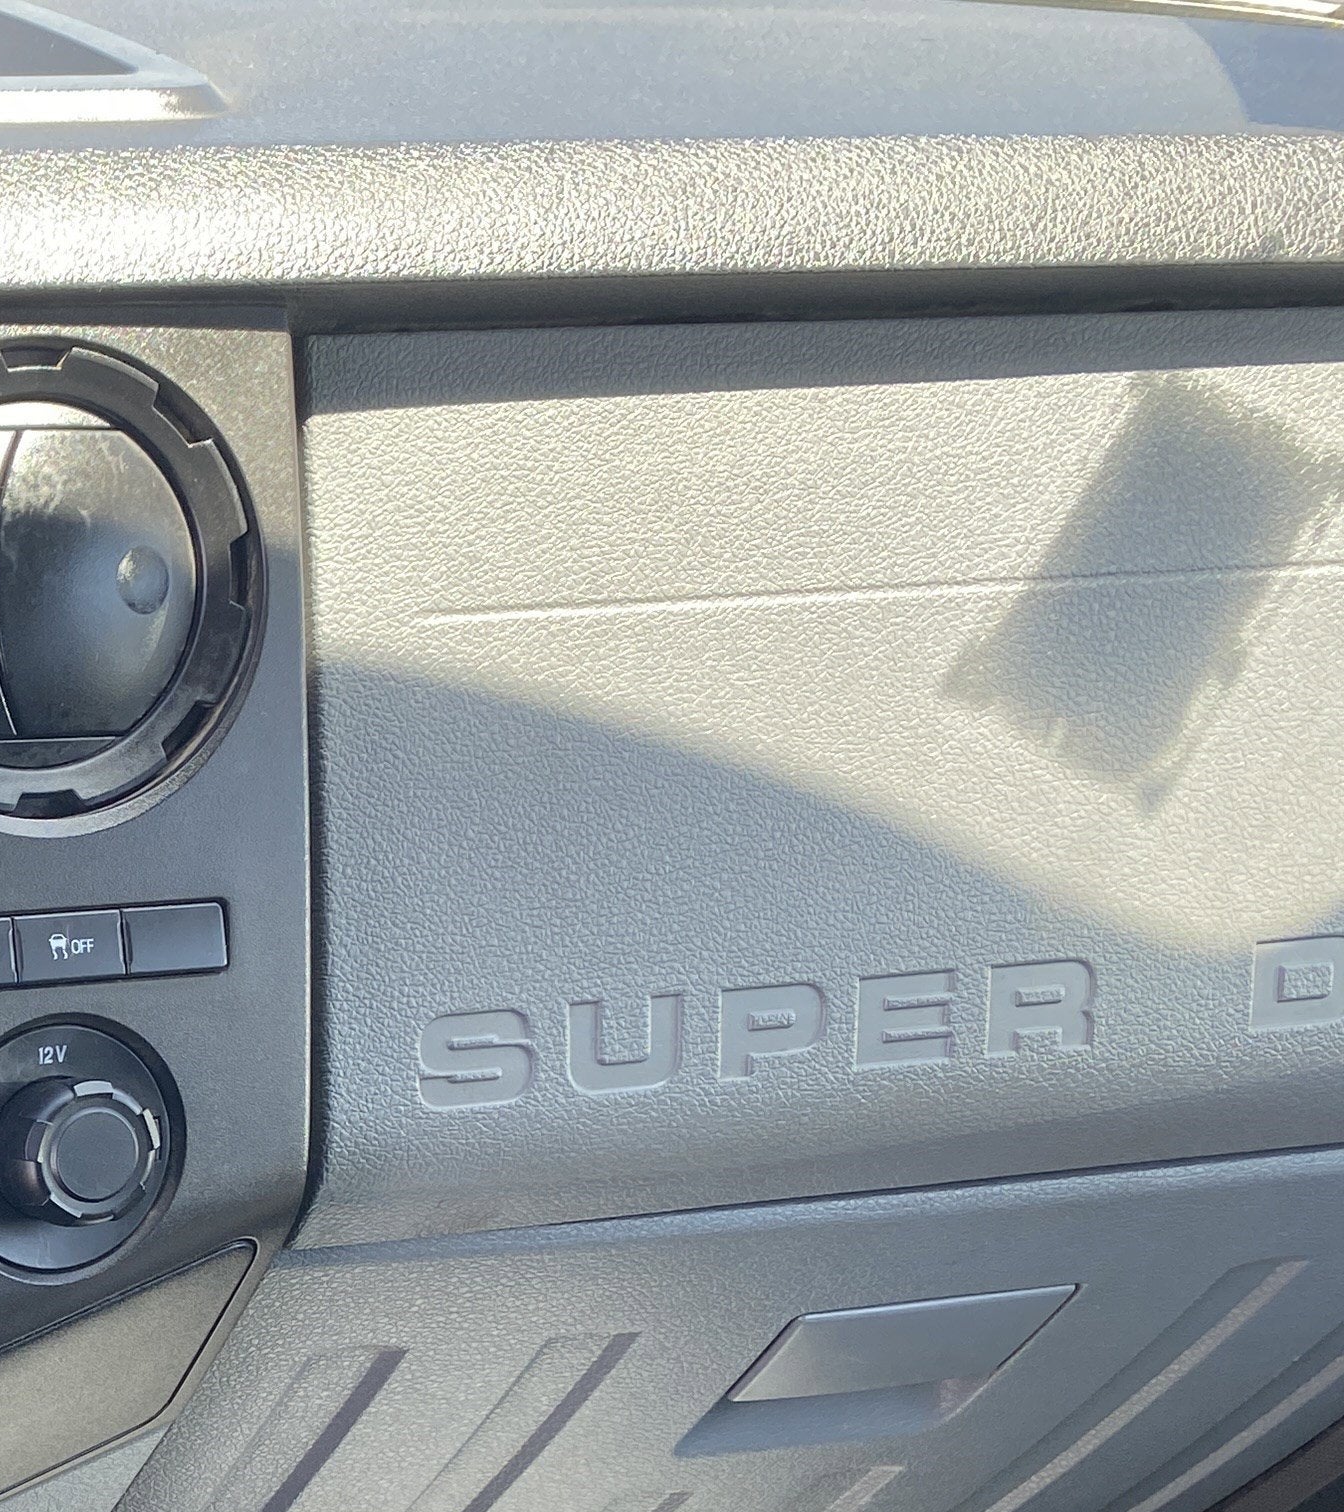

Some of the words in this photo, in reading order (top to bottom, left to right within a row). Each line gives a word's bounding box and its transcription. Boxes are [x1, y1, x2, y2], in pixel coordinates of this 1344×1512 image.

[71, 938, 94, 954] OFF
[417, 958, 1096, 1111] SUPER
[38, 1045, 67, 1065] 12V
